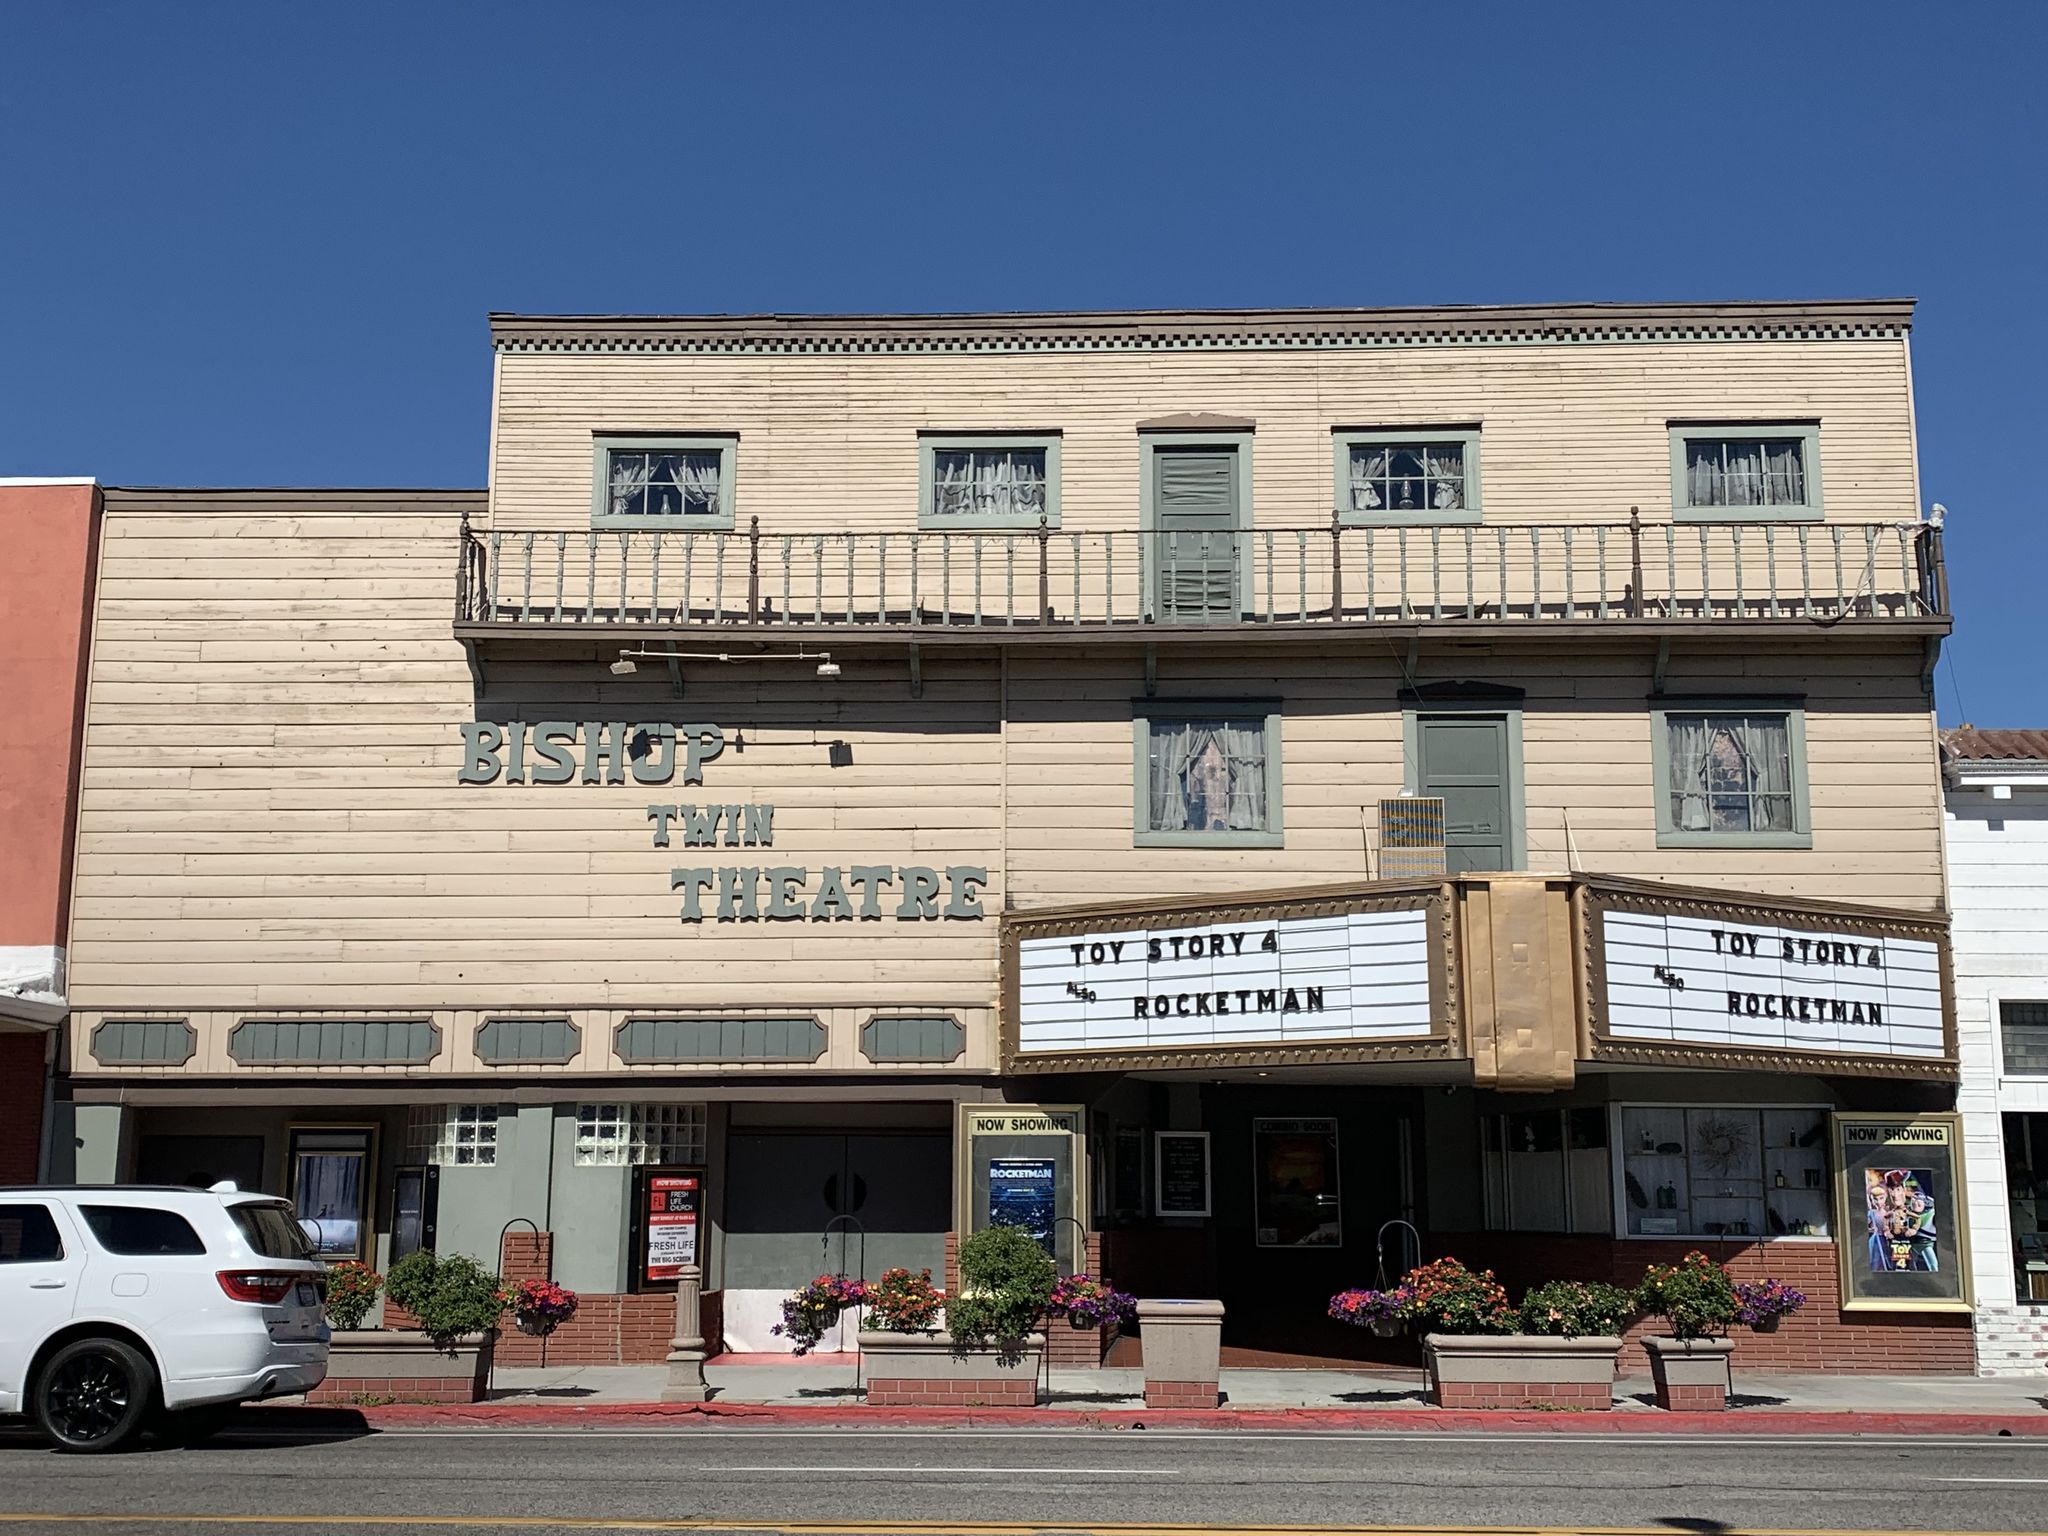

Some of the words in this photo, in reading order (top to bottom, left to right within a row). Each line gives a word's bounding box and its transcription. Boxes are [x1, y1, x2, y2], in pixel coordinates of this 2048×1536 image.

[458, 721, 724, 785] BISHOP
[647, 804, 774, 847] TWIN
[671, 865, 987, 922] THEATRE
[1070, 940, 1125, 966] TOY
[1147, 932, 1245, 962] STORY
[1261, 929, 1278, 953] 4
[1711, 930, 1760, 958] TOY
[1782, 936, 1861, 968] STORY
[1867, 945, 1881, 969] 4
[1066, 981, 1097, 1003] ALSO
[1653, 964, 1685, 992] ALSO
[1134, 986, 1324, 1020] ROCKETMAN
[1727, 990, 1882, 1026] ROCKETMAN
[977, 1119, 1005, 1131] NOW
[1011, 1119, 1068, 1131] SHOWING
[1849, 1128, 1877, 1141] NOW
[1884, 1128, 1943, 1141] SHOWING
[990, 1168, 1052, 1178] ROCKETMAN
[649, 1241, 676, 1251] FRESH
[678, 1240, 694, 1250] LIFE
[1891, 1244, 1912, 1254] TOY
[1896, 1258, 1907, 1268] 4
